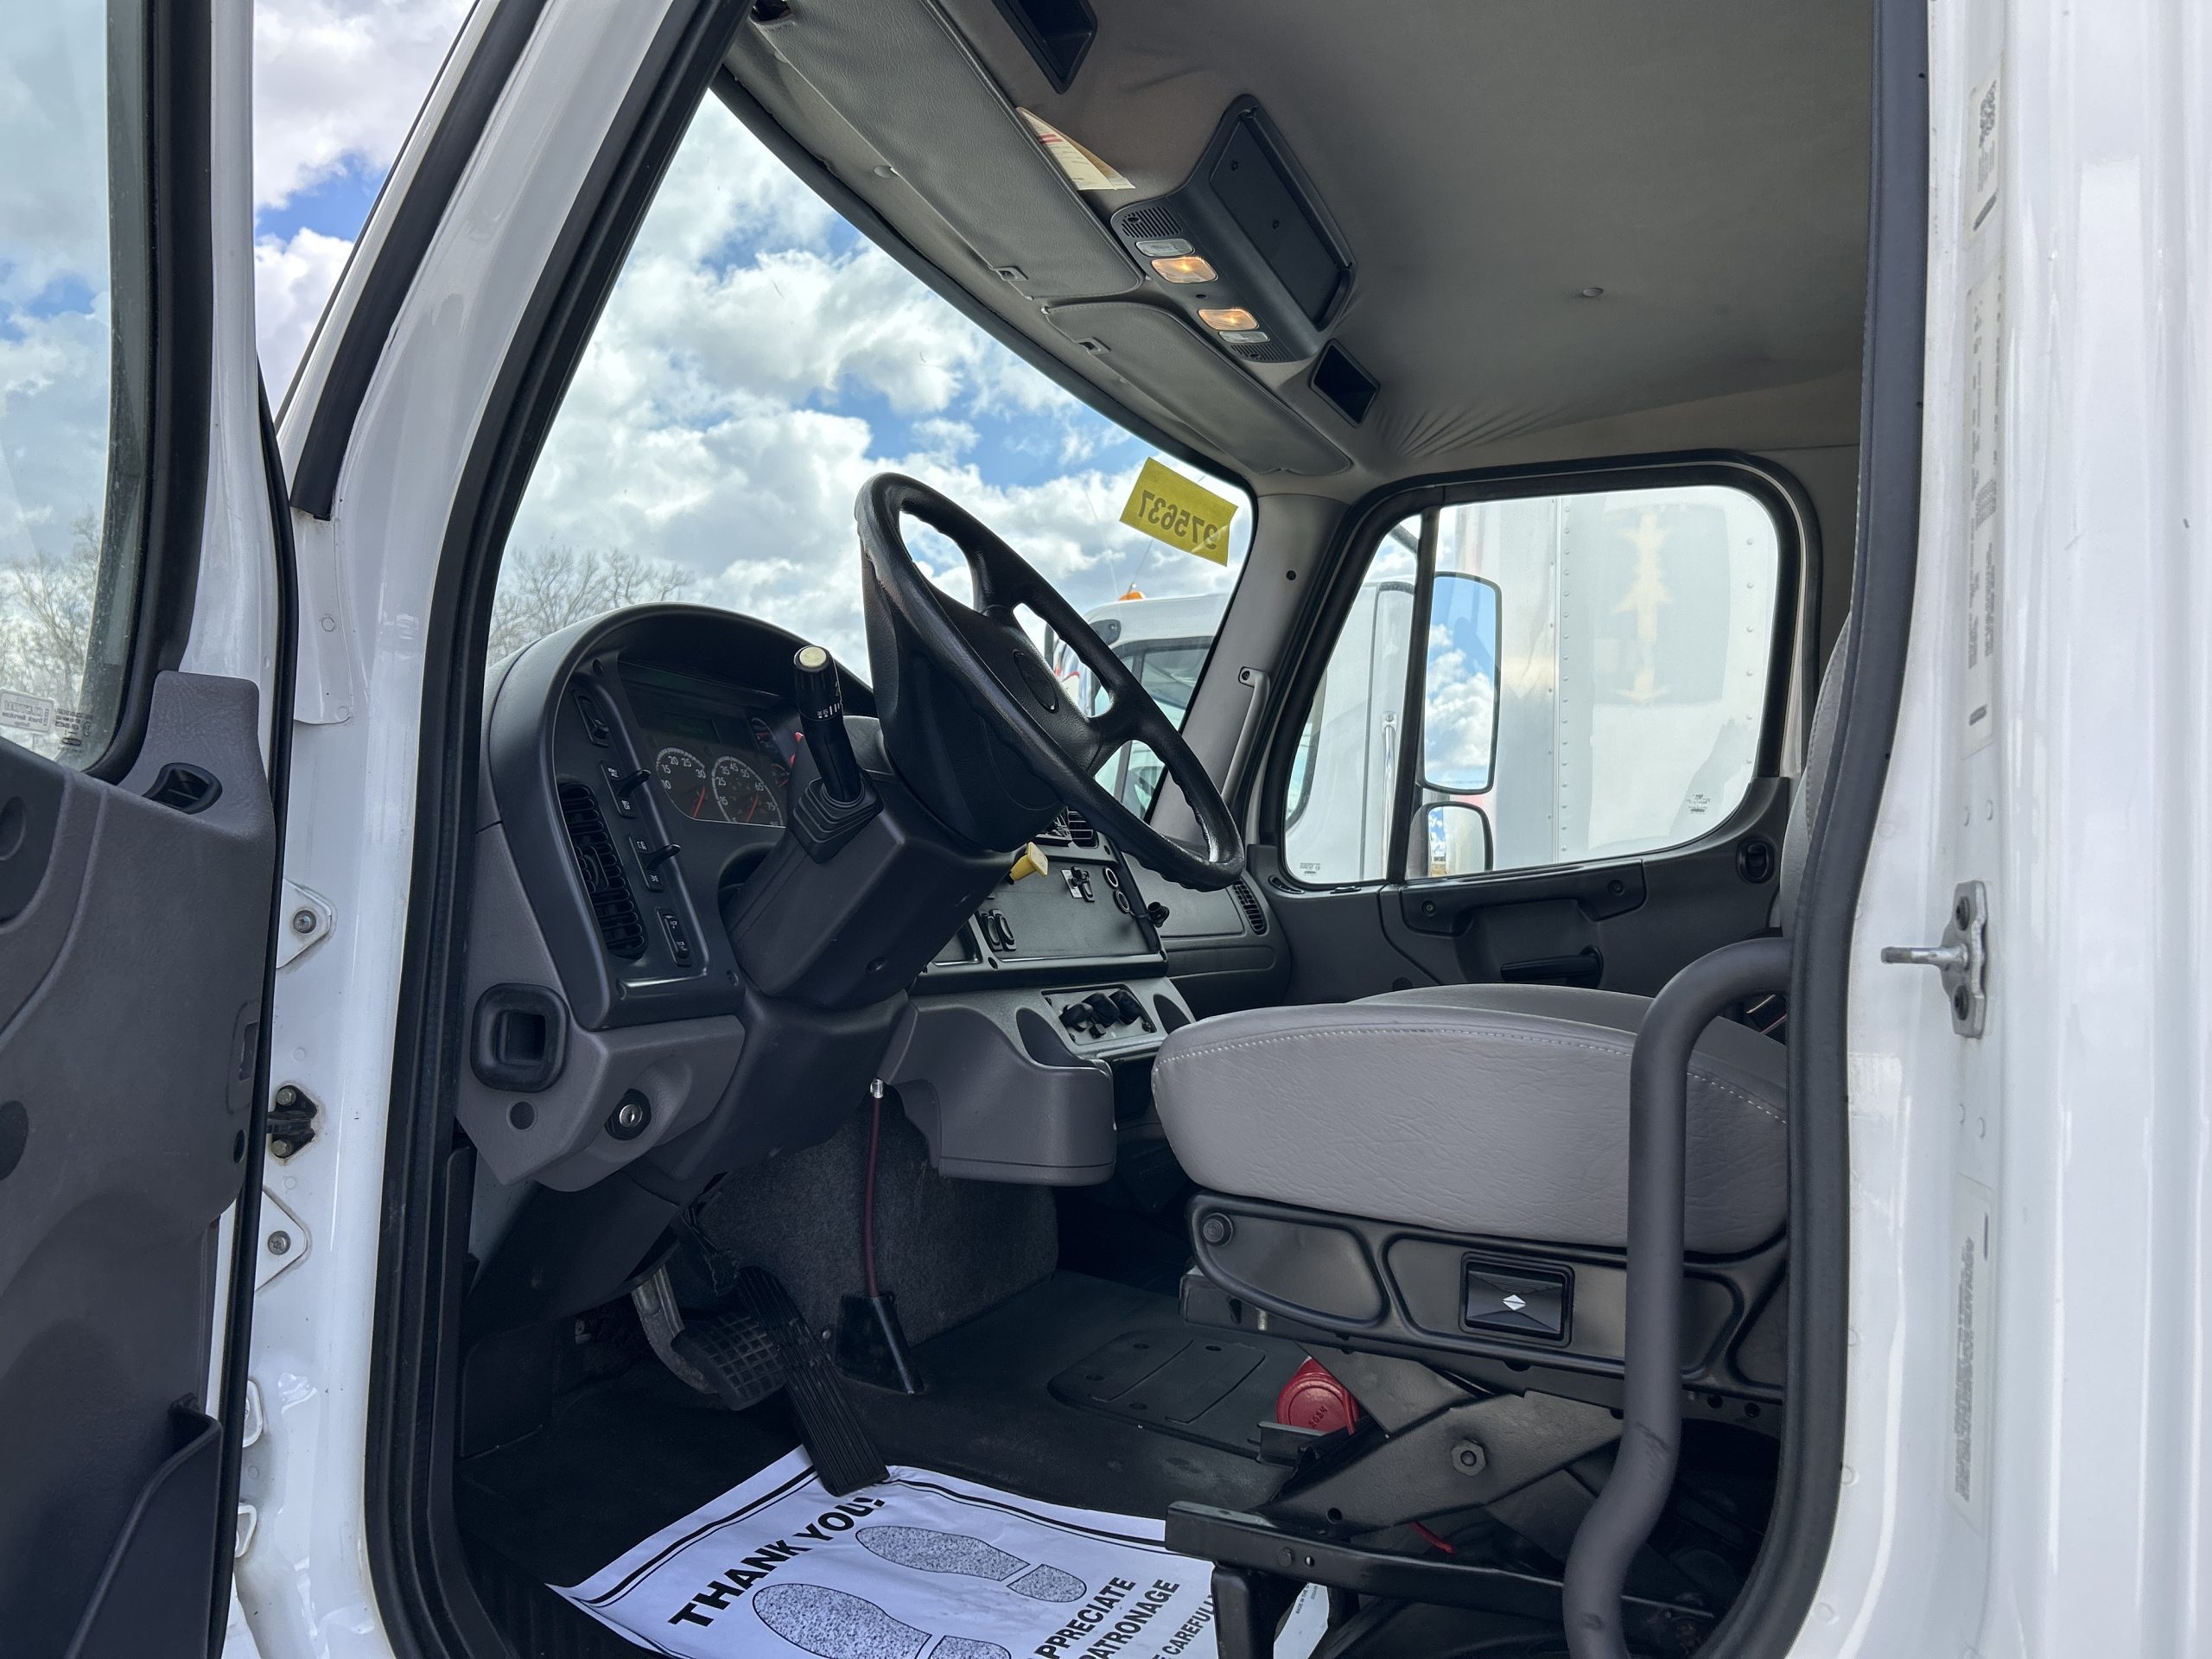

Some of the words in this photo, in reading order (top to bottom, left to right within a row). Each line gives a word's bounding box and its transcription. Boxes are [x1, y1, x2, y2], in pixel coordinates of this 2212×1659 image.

[668, 755, 678, 766] 20
[681, 758, 691, 767] 25
[661, 765, 671, 773] 15
[721, 766, 730, 775] 35
[729, 763, 739, 772] 45
[696, 769, 706, 779] 30
[661, 779, 671, 789] 10
[716, 777, 727, 786] 25
[754, 782, 765, 791] 65
[719, 796, 728, 805] 15
[766, 801, 776, 810] 75
[667, 1540, 813, 1627] THANK
[792, 1497, 886, 1541] YOU!
[1028, 1577, 1136, 1659] PPRECIATE
